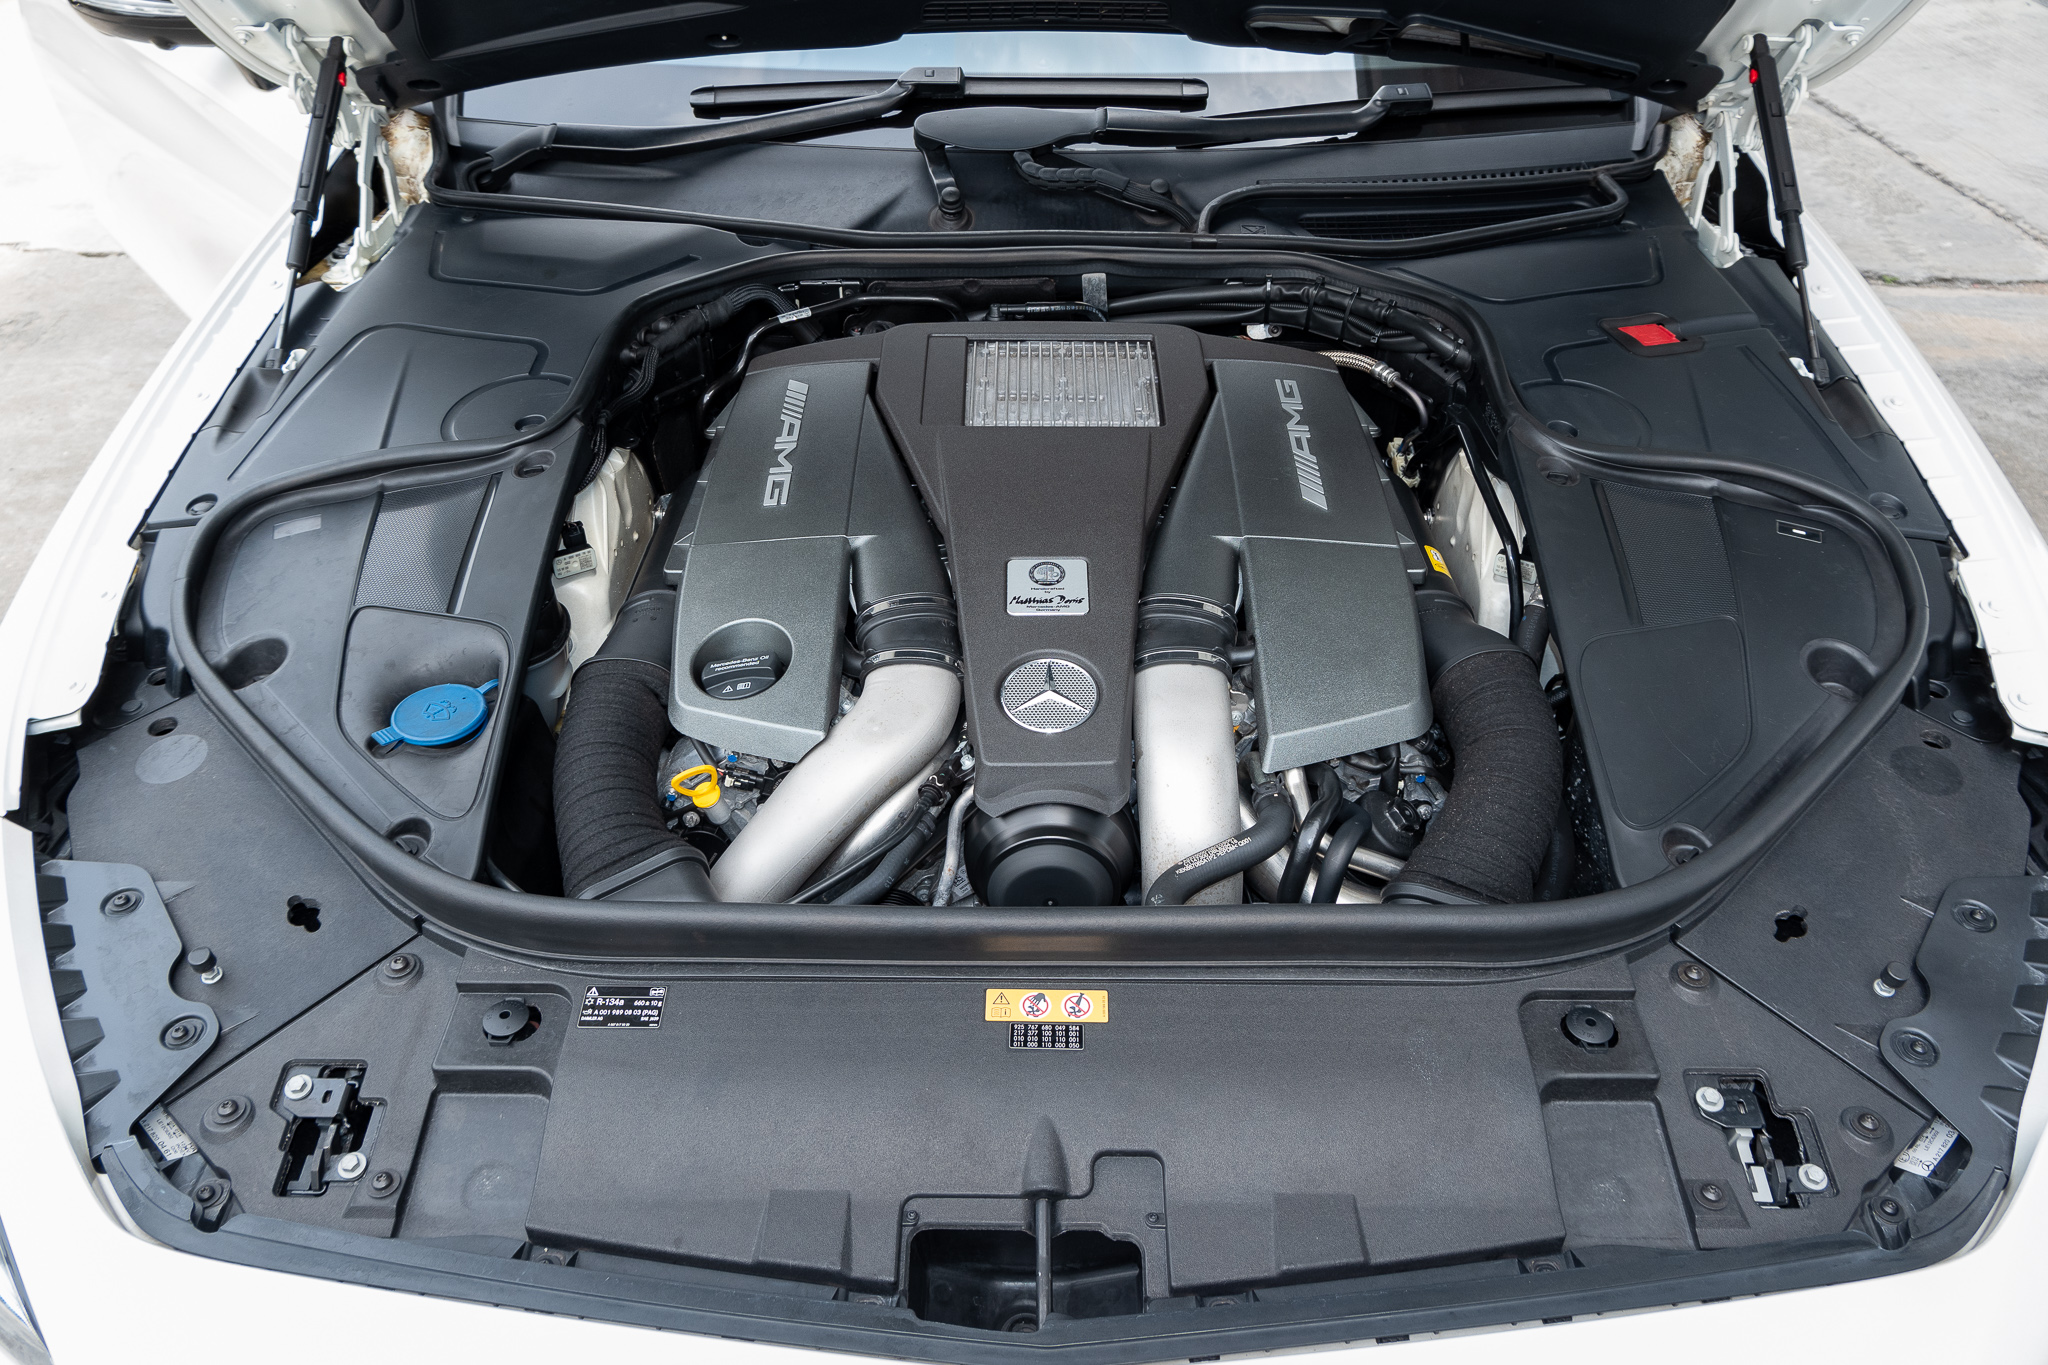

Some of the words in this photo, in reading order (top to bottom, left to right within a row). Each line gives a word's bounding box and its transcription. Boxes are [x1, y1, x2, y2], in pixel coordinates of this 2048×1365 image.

[1275, 379, 1318, 464] AMG
[763, 411, 803, 507] AMG
[709, 656, 759, 669] Mercedes-Benz
[714, 660, 760, 672] recommended
[595, 997, 625, 1006] R-134a
